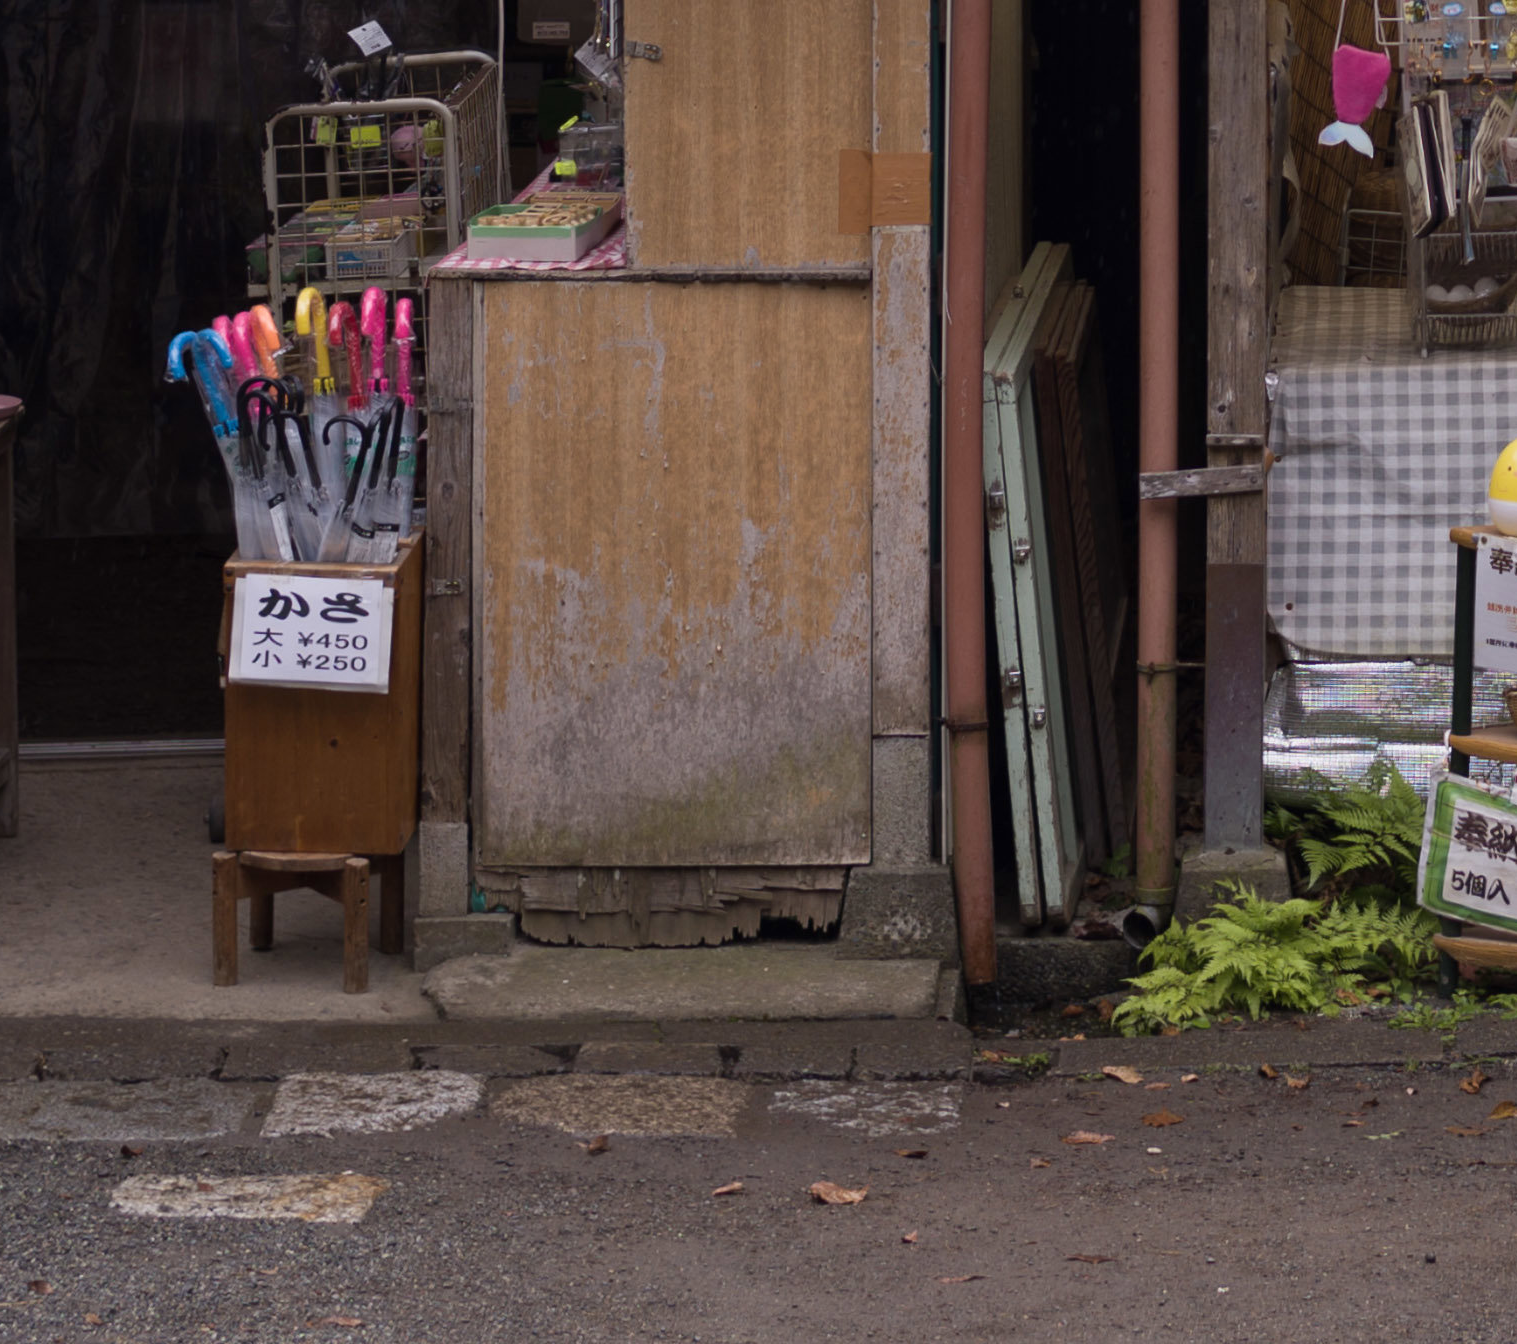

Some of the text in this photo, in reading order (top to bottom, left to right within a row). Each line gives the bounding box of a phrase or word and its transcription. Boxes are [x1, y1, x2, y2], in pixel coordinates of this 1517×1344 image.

[257, 587, 369, 624] かさ
[252, 628, 369, 651] 大 ¥450
[251, 650, 367, 672] 小 ¥250
[1452, 868, 1511, 905] 5個入
